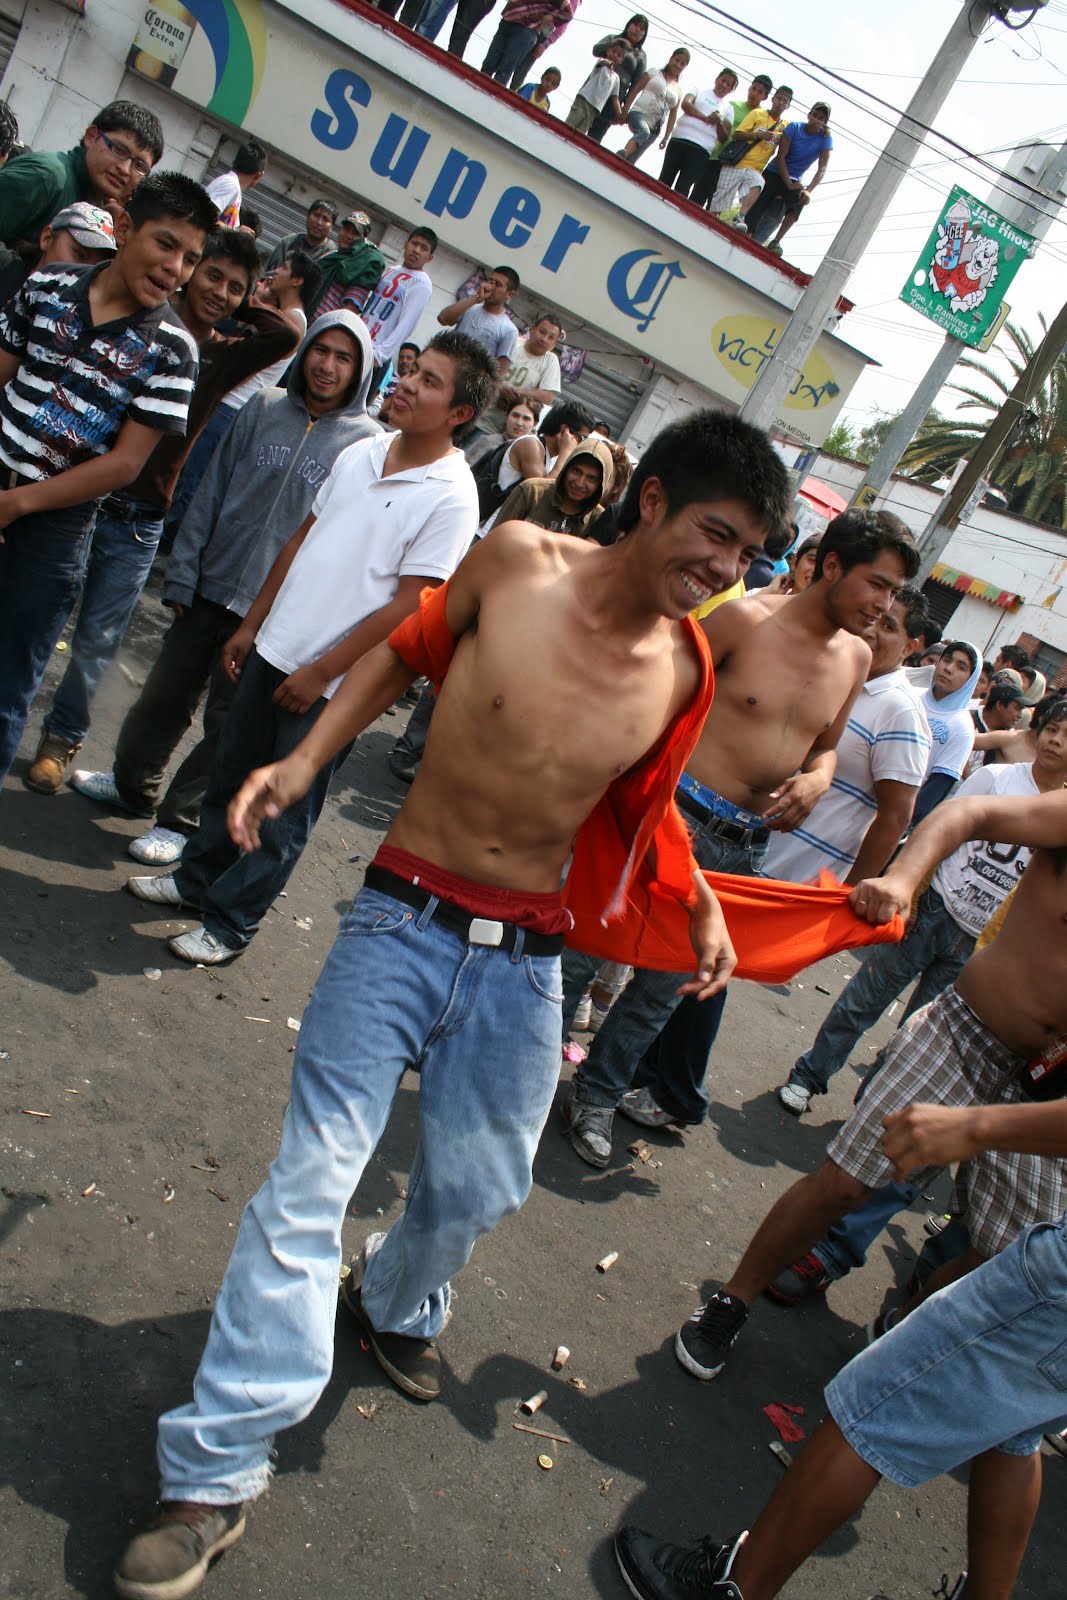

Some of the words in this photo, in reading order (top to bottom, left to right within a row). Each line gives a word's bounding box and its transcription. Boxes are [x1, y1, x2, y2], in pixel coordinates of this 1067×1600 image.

[144, 9, 185, 41] Corona
[149, 27, 175, 48] Extra
[310, 68, 591, 274] Super
[909, 298, 930, 318] Xoch.
[932, 312, 969, 339] CENTRO
[910, 288, 927, 306] Gpe.
[969, 325, 976, 333] 9
[764, 328, 777, 350] L
[787, 424, 811, 441] MEDIDA
